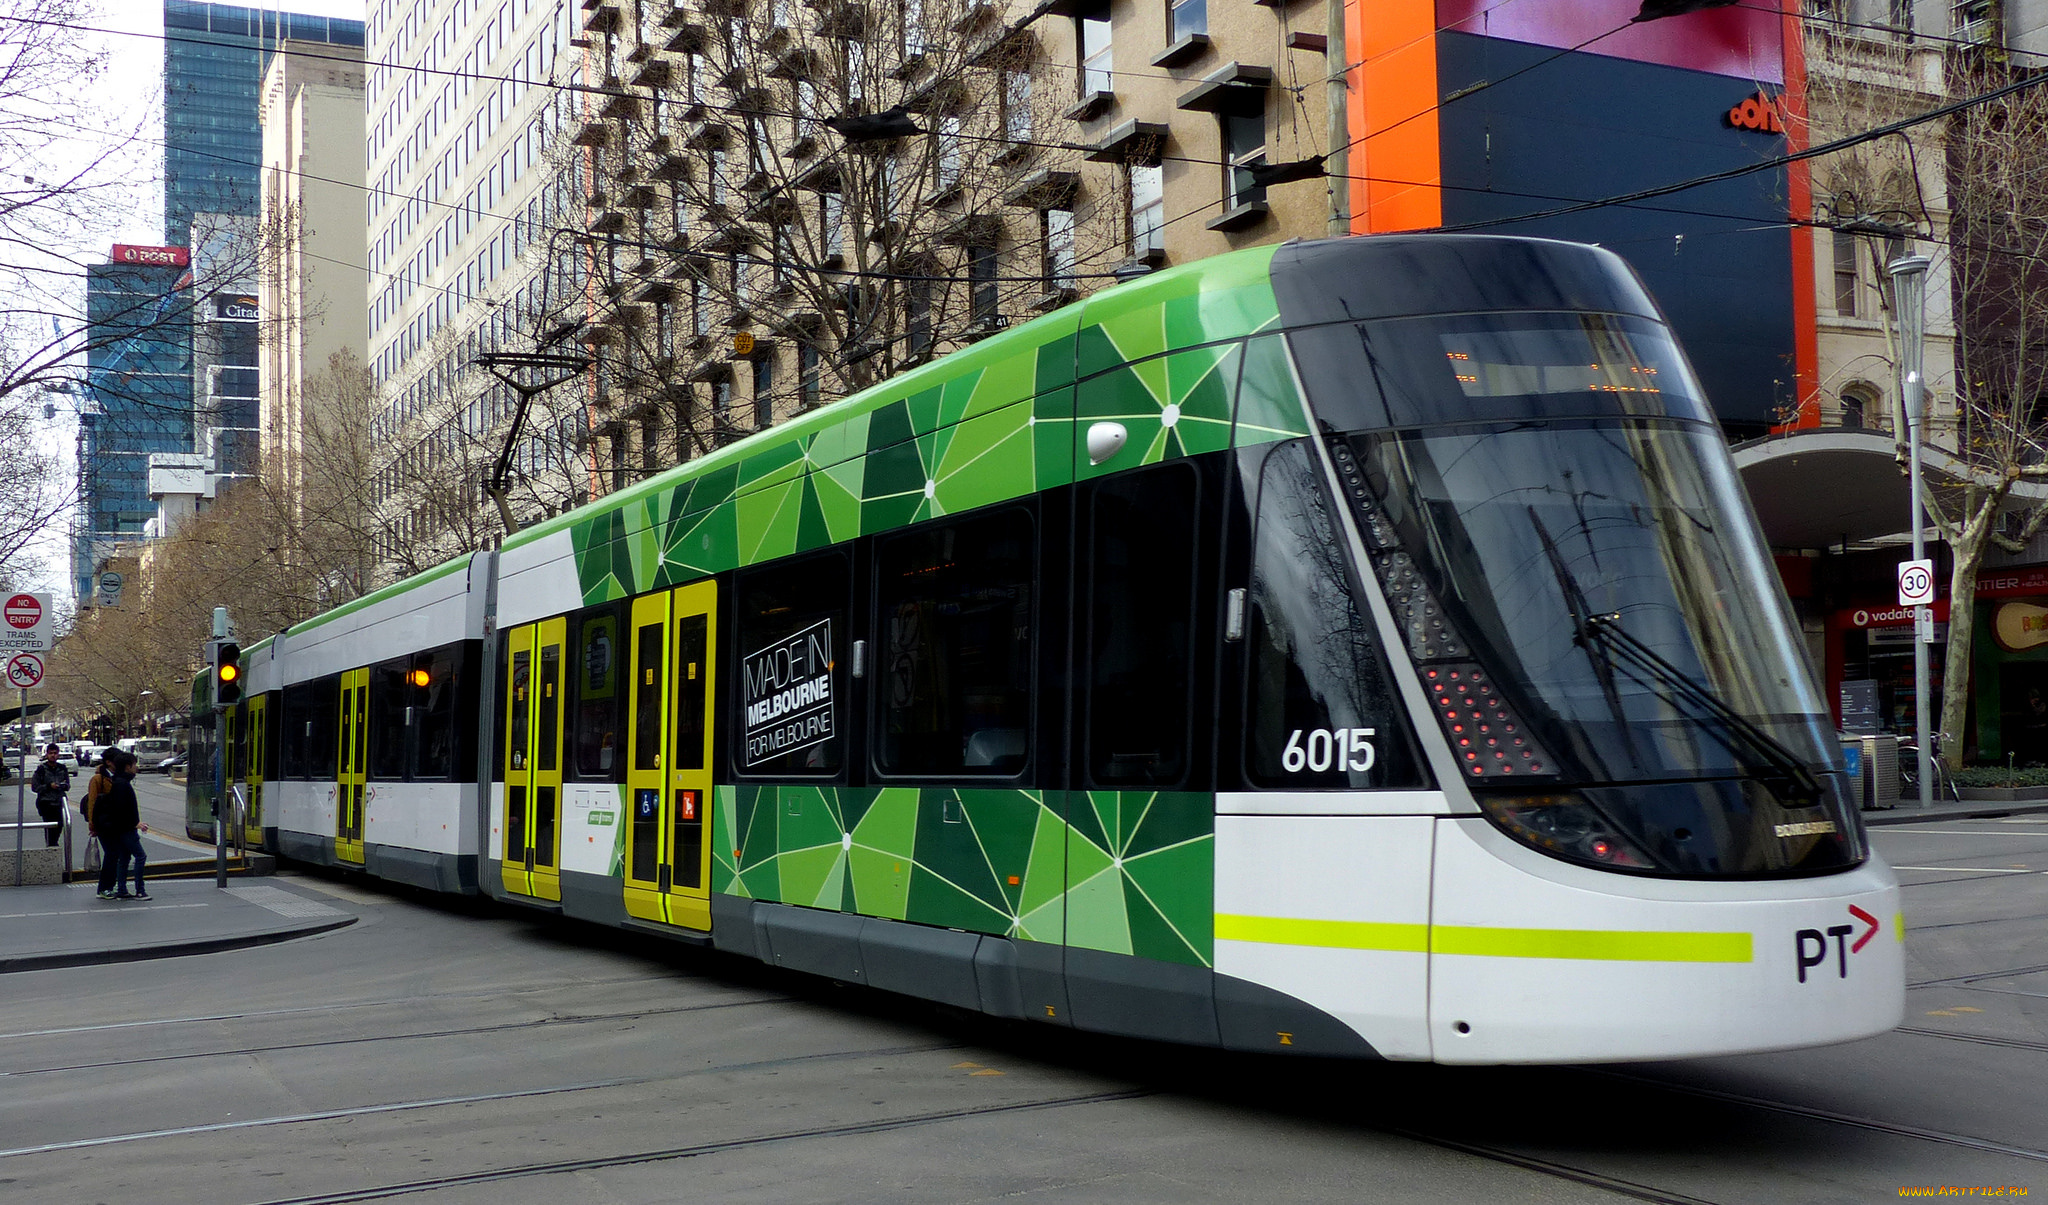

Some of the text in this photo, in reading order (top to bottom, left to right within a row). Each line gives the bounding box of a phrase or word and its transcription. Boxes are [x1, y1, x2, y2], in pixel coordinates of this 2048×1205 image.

[139, 251, 177, 263] POST
[996, 317, 1007, 327] 41
[737, 335, 751, 343] CUT
[737, 343, 751, 351] OFF
[1904, 574, 1927, 591] 30
[1940, 577, 2019, 595] FNTIER
[17, 599, 30, 607] NO
[9, 616, 37, 624] ENTRY
[1871, 608, 1916, 622] vodafo
[6, 631, 37, 639] TRAMS
[0, 640, 44, 648] EXCEPTED
[746, 627, 829, 702] MADE IN
[747, 674, 830, 728] MELBOURNE
[748, 711, 831, 759] FOR MELBOURNE
[1282, 728, 1376, 773] 6015
